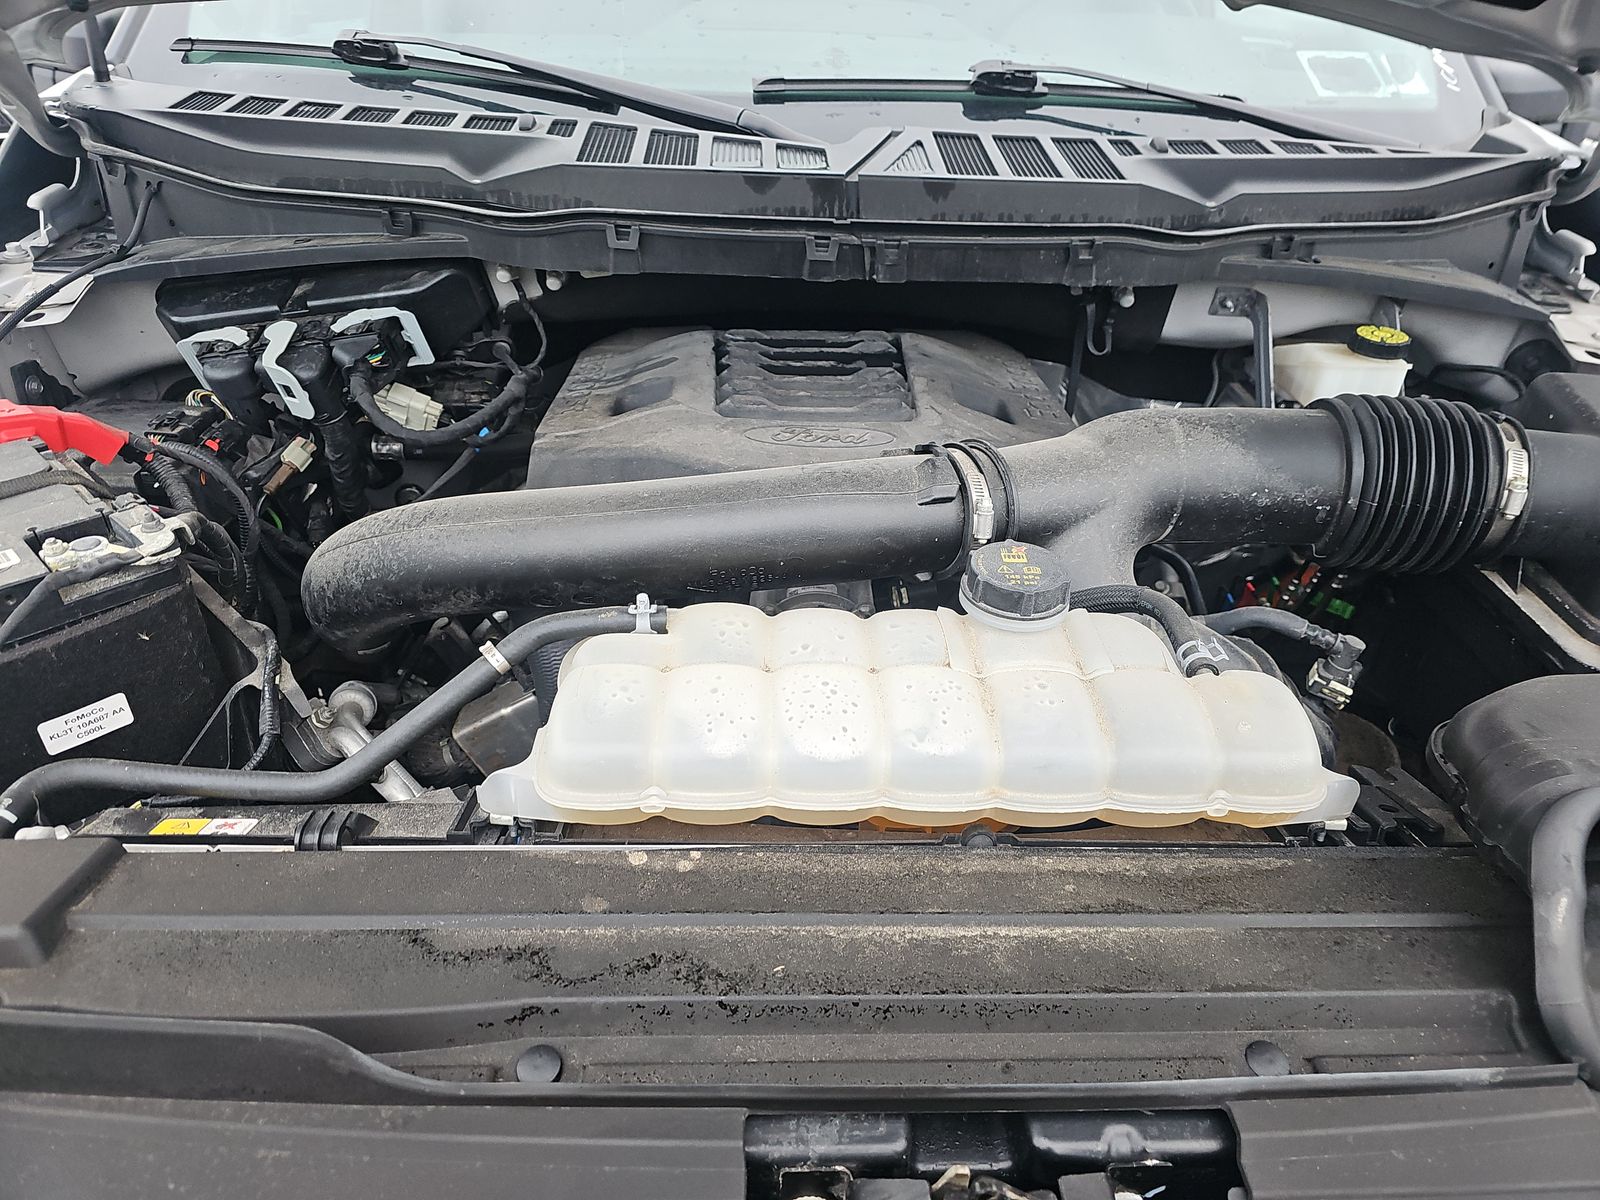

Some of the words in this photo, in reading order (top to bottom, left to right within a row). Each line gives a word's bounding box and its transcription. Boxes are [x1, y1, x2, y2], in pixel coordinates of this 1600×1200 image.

[771, 425, 869, 444] Ford
[49, 726, 74, 741] KL3T
[112, 706, 126, 716] AA
[64, 706, 105, 726] FoMoCo
[76, 724, 106, 739] C500L
